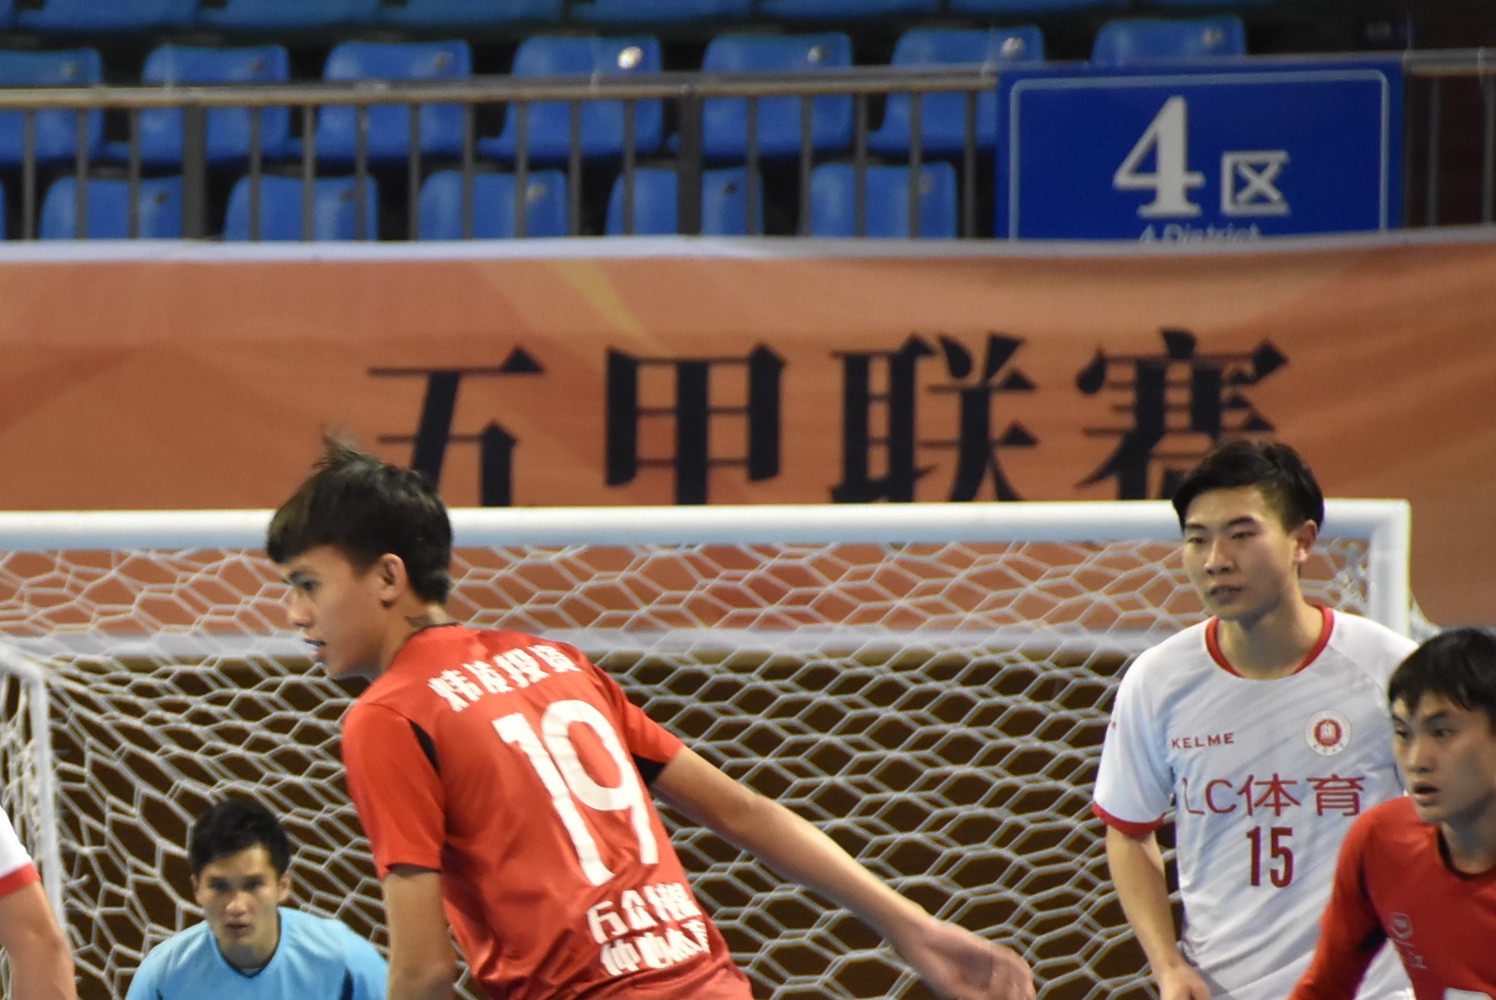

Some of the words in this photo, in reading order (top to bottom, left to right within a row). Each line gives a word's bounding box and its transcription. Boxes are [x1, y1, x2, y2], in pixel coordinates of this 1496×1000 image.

[367, 328, 1289, 508] 五甲联赛
[1171, 732, 1235, 749] KELME
[492, 699, 659, 887] 19
[1182, 773, 1367, 818] LC体育
[1245, 825, 1294, 888] 15
